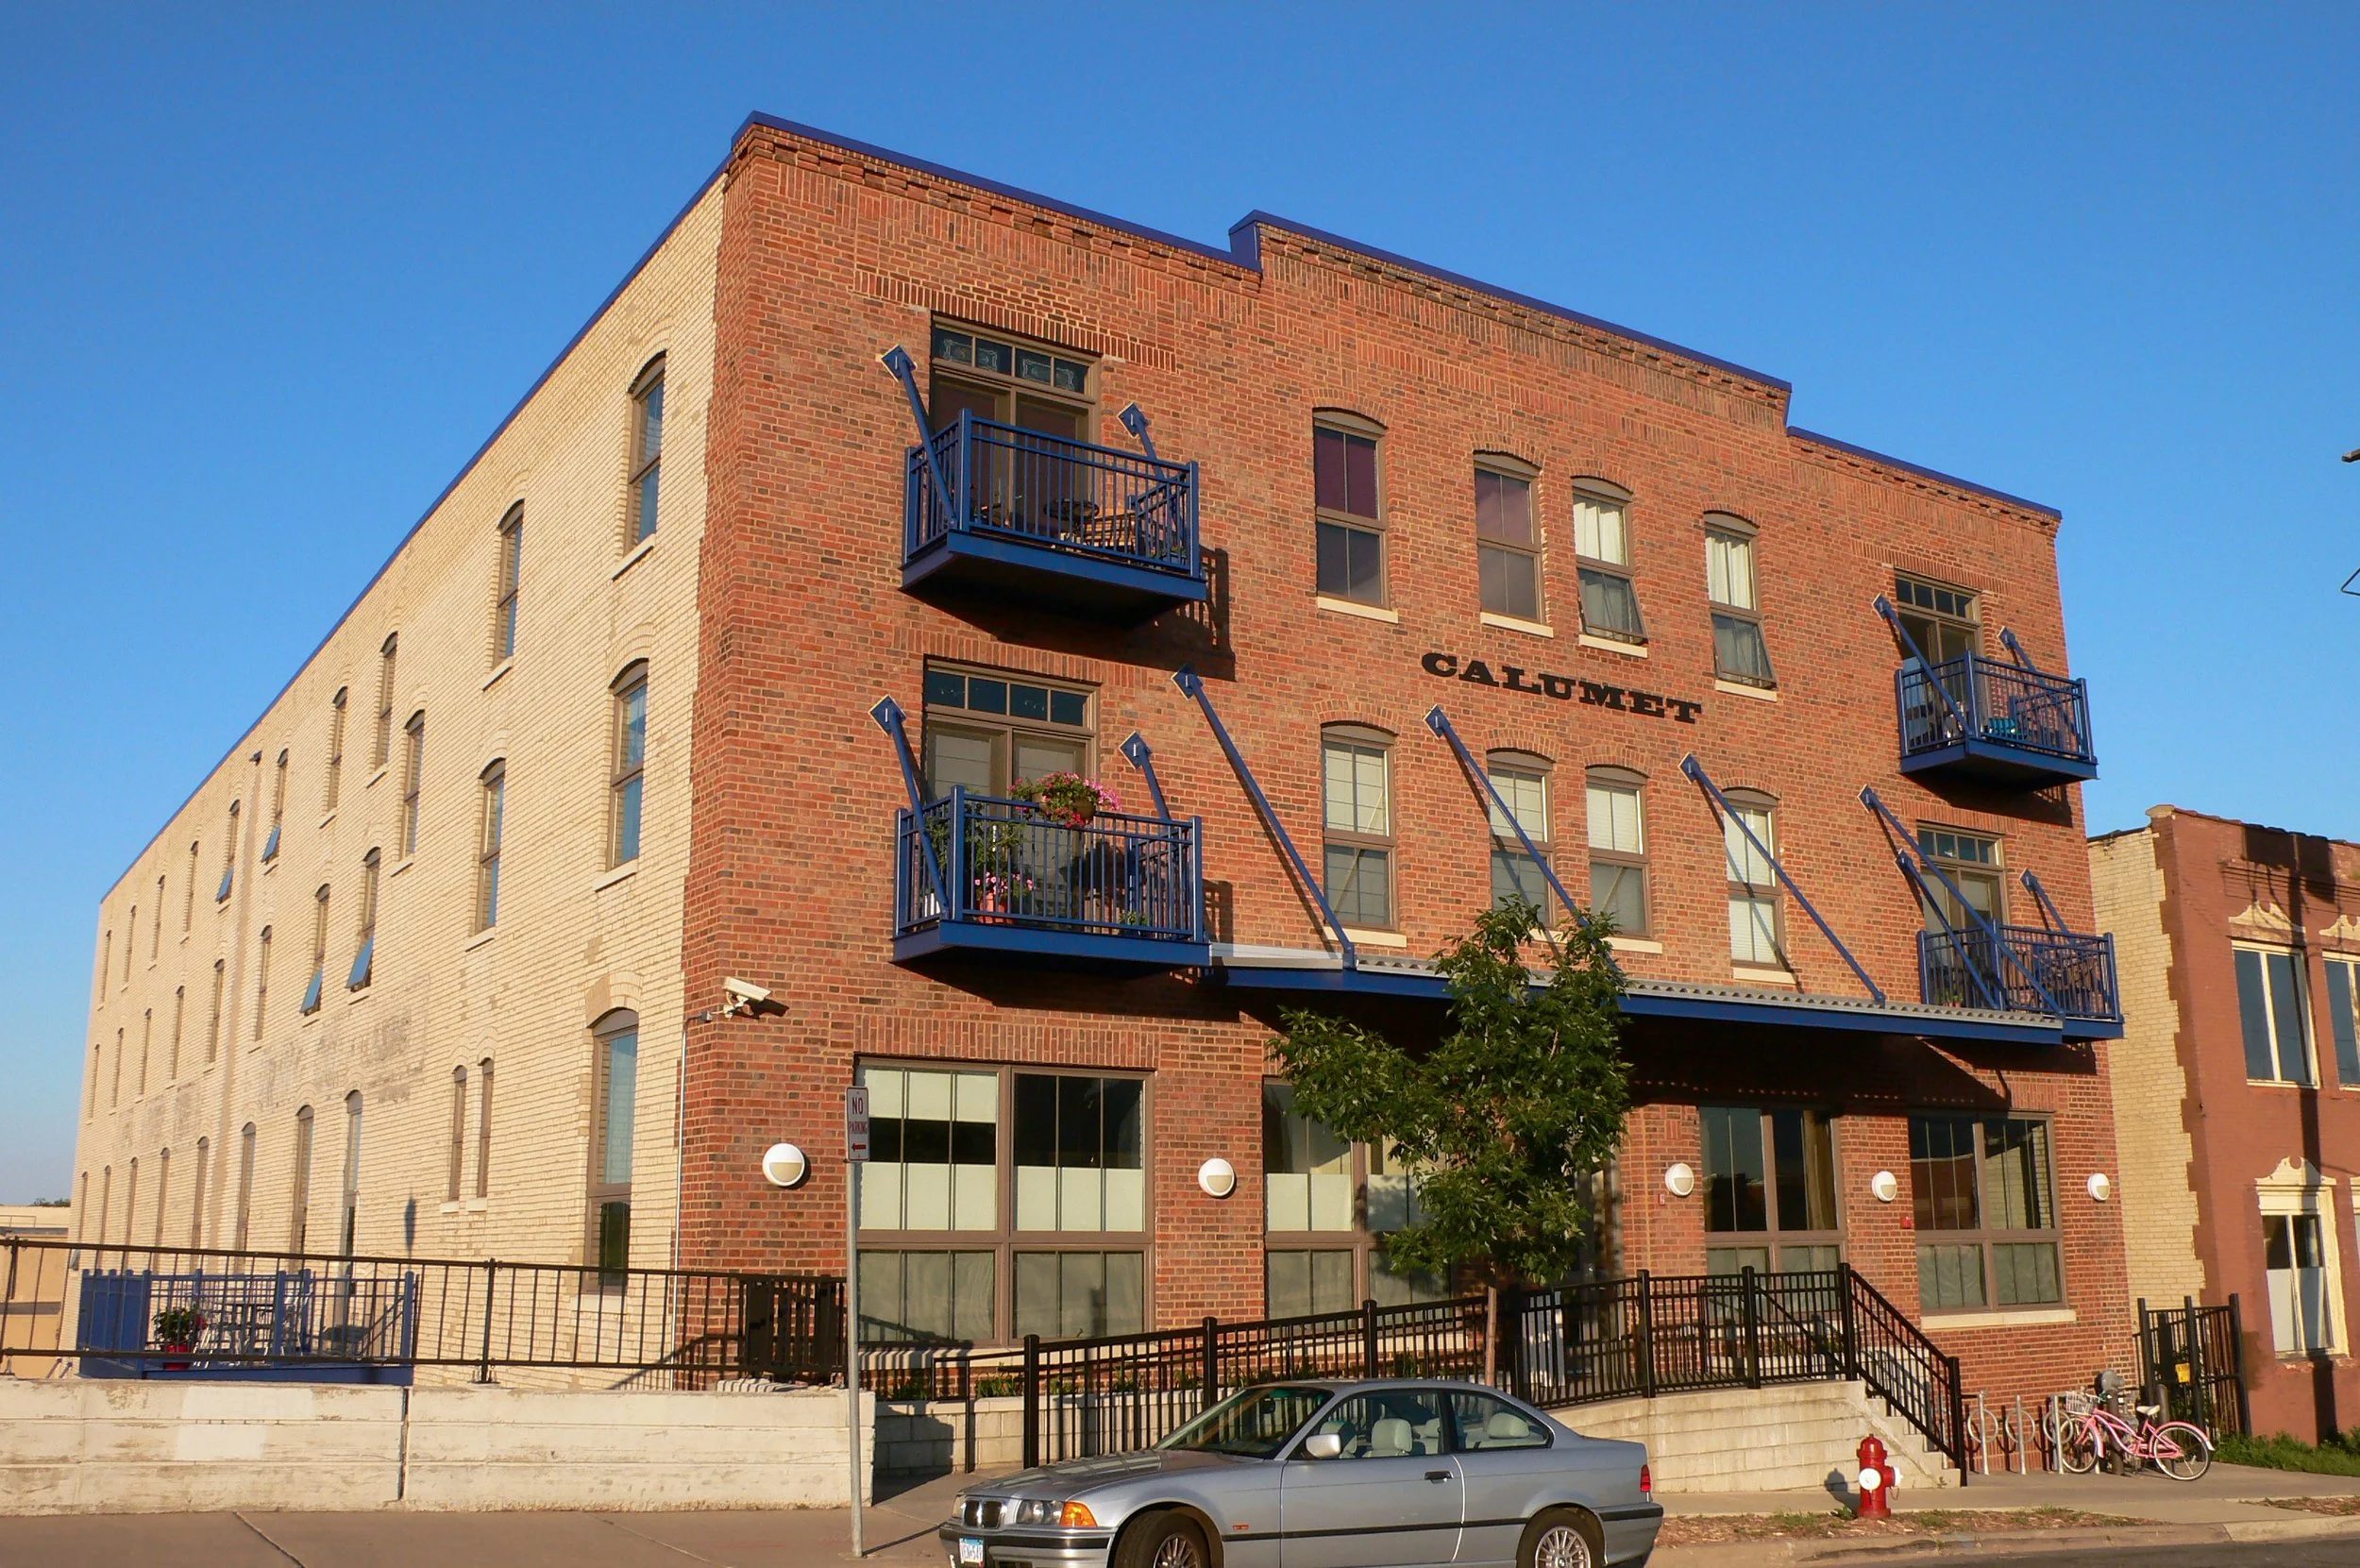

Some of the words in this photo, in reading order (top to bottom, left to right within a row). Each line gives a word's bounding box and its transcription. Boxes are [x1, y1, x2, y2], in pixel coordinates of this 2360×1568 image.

[1421, 652, 1703, 724] CALUMET
[851, 1097, 864, 1115] NO
[849, 1121, 868, 1135] PARKING
